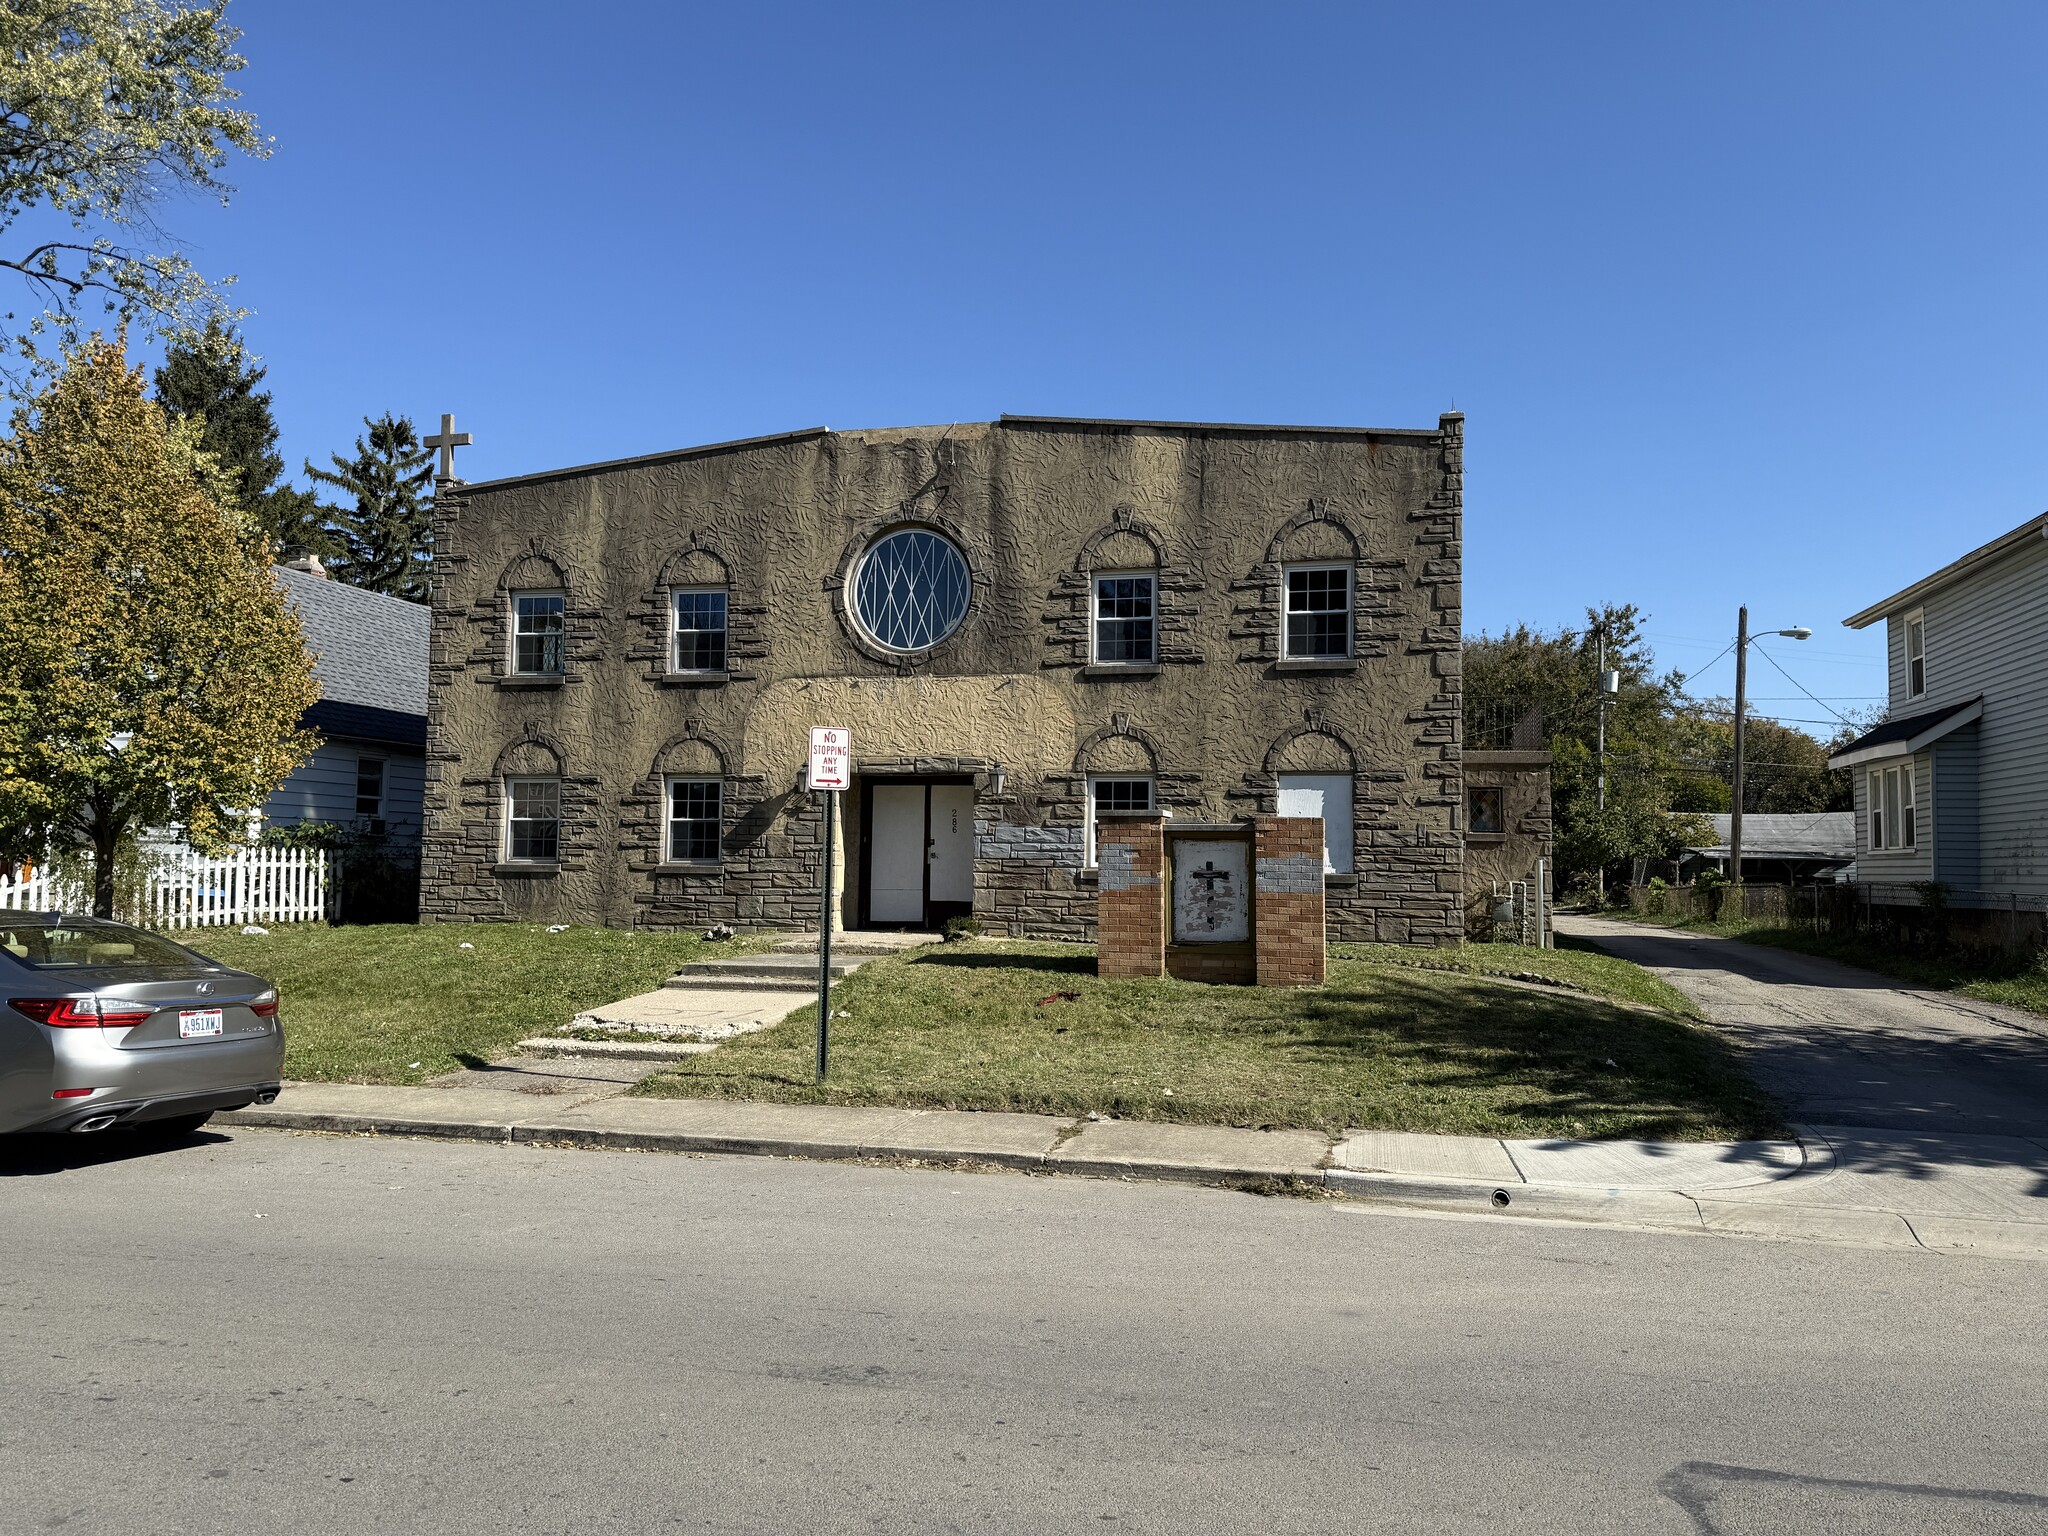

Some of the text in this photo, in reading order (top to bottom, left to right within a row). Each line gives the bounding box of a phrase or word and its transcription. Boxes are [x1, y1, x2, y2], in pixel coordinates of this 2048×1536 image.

[824, 733, 837, 743] NO
[813, 745, 847, 756] STOPPING
[823, 757, 837, 765] ANY
[821, 766, 838, 774] TIME
